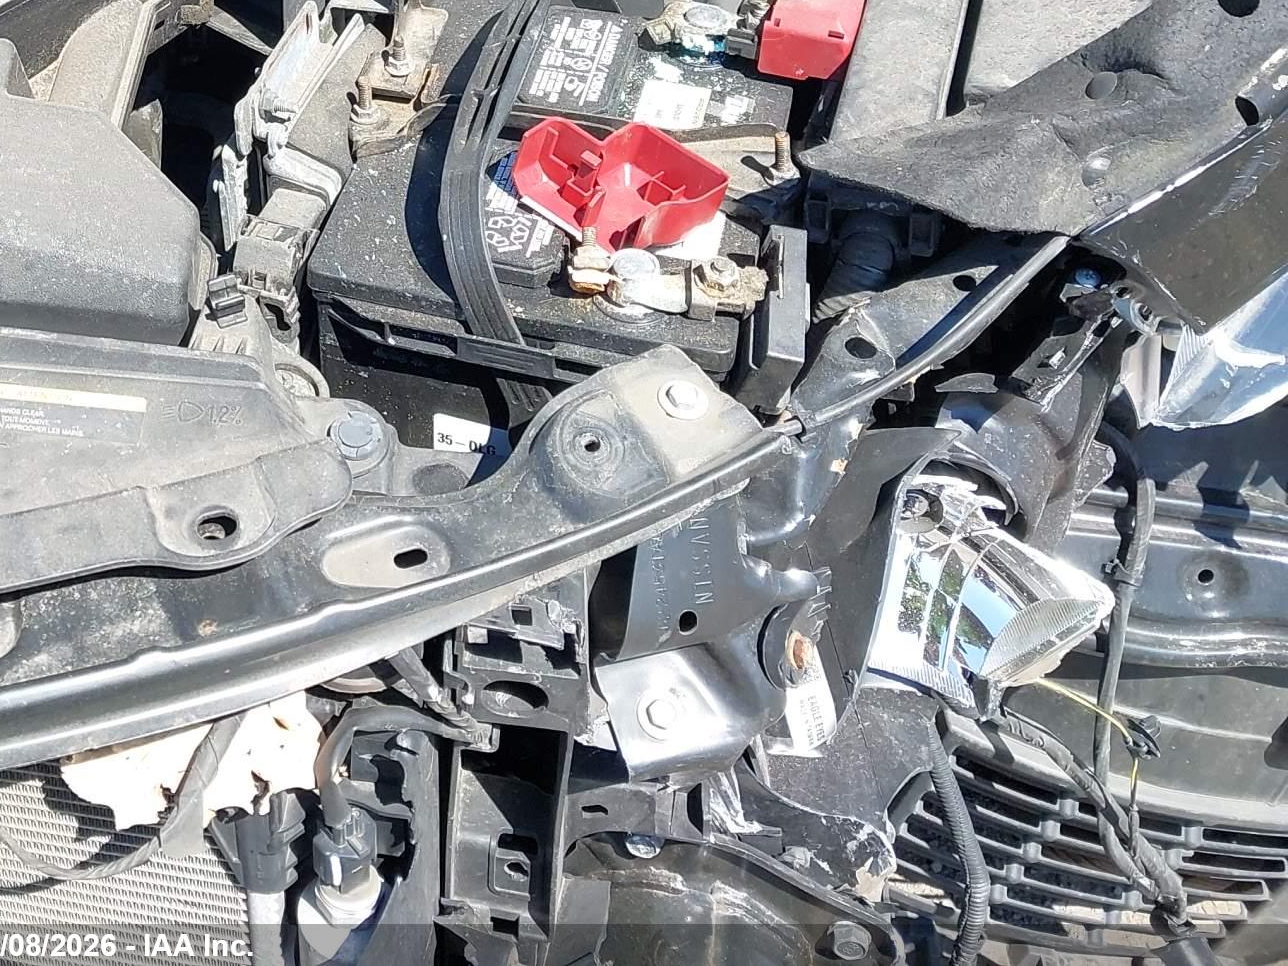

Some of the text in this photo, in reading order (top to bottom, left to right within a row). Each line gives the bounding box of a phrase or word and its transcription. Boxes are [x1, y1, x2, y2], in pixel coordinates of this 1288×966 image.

[599, 32, 619, 66] DANGER
[586, 70, 606, 104] POISON
[808, 696, 822, 722] EAGLE
